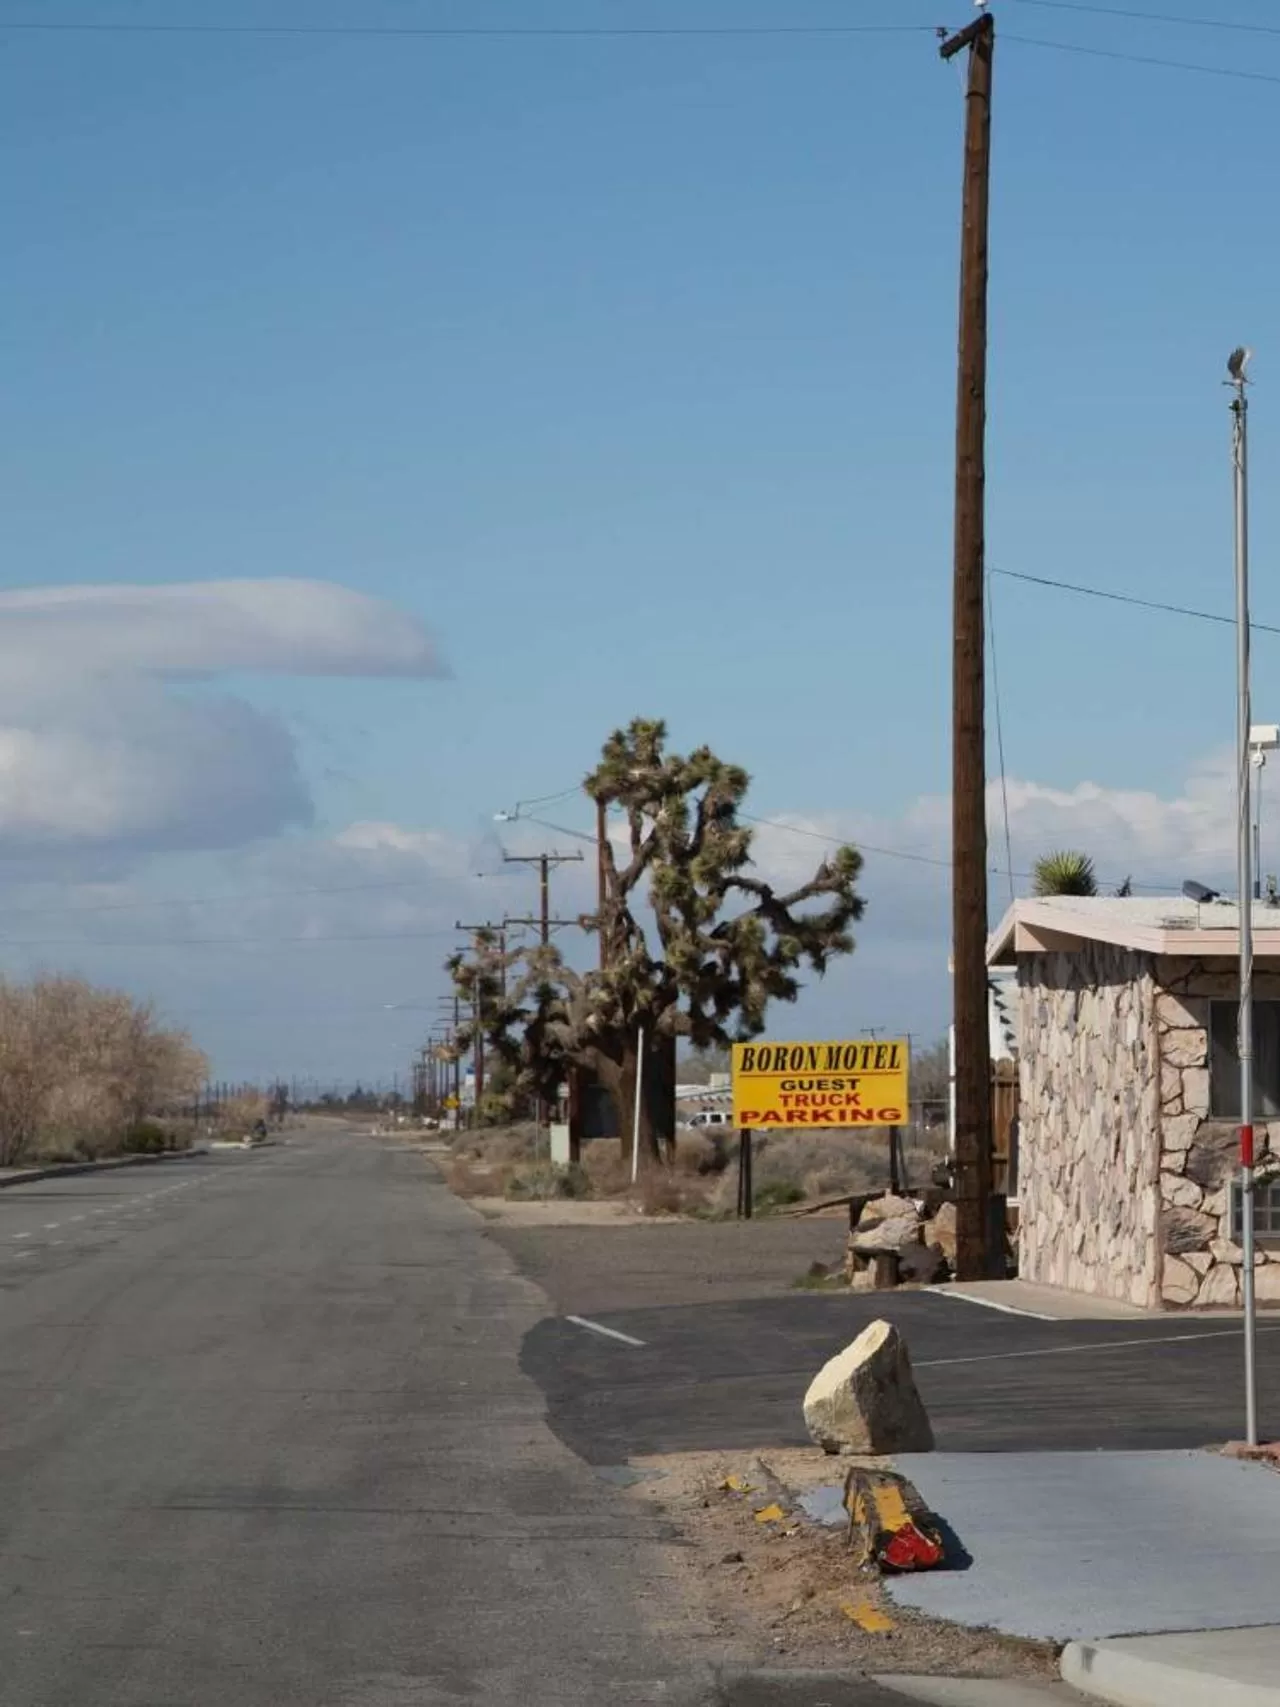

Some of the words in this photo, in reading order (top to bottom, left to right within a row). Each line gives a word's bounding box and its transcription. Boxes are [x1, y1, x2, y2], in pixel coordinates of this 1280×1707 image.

[740, 1046, 821, 1073] BORON
[823, 1044, 901, 1071] MOTEL
[780, 1078, 861, 1092] GUEST
[778, 1093, 861, 1107] TRUCK
[740, 1108, 902, 1124] PARKING
